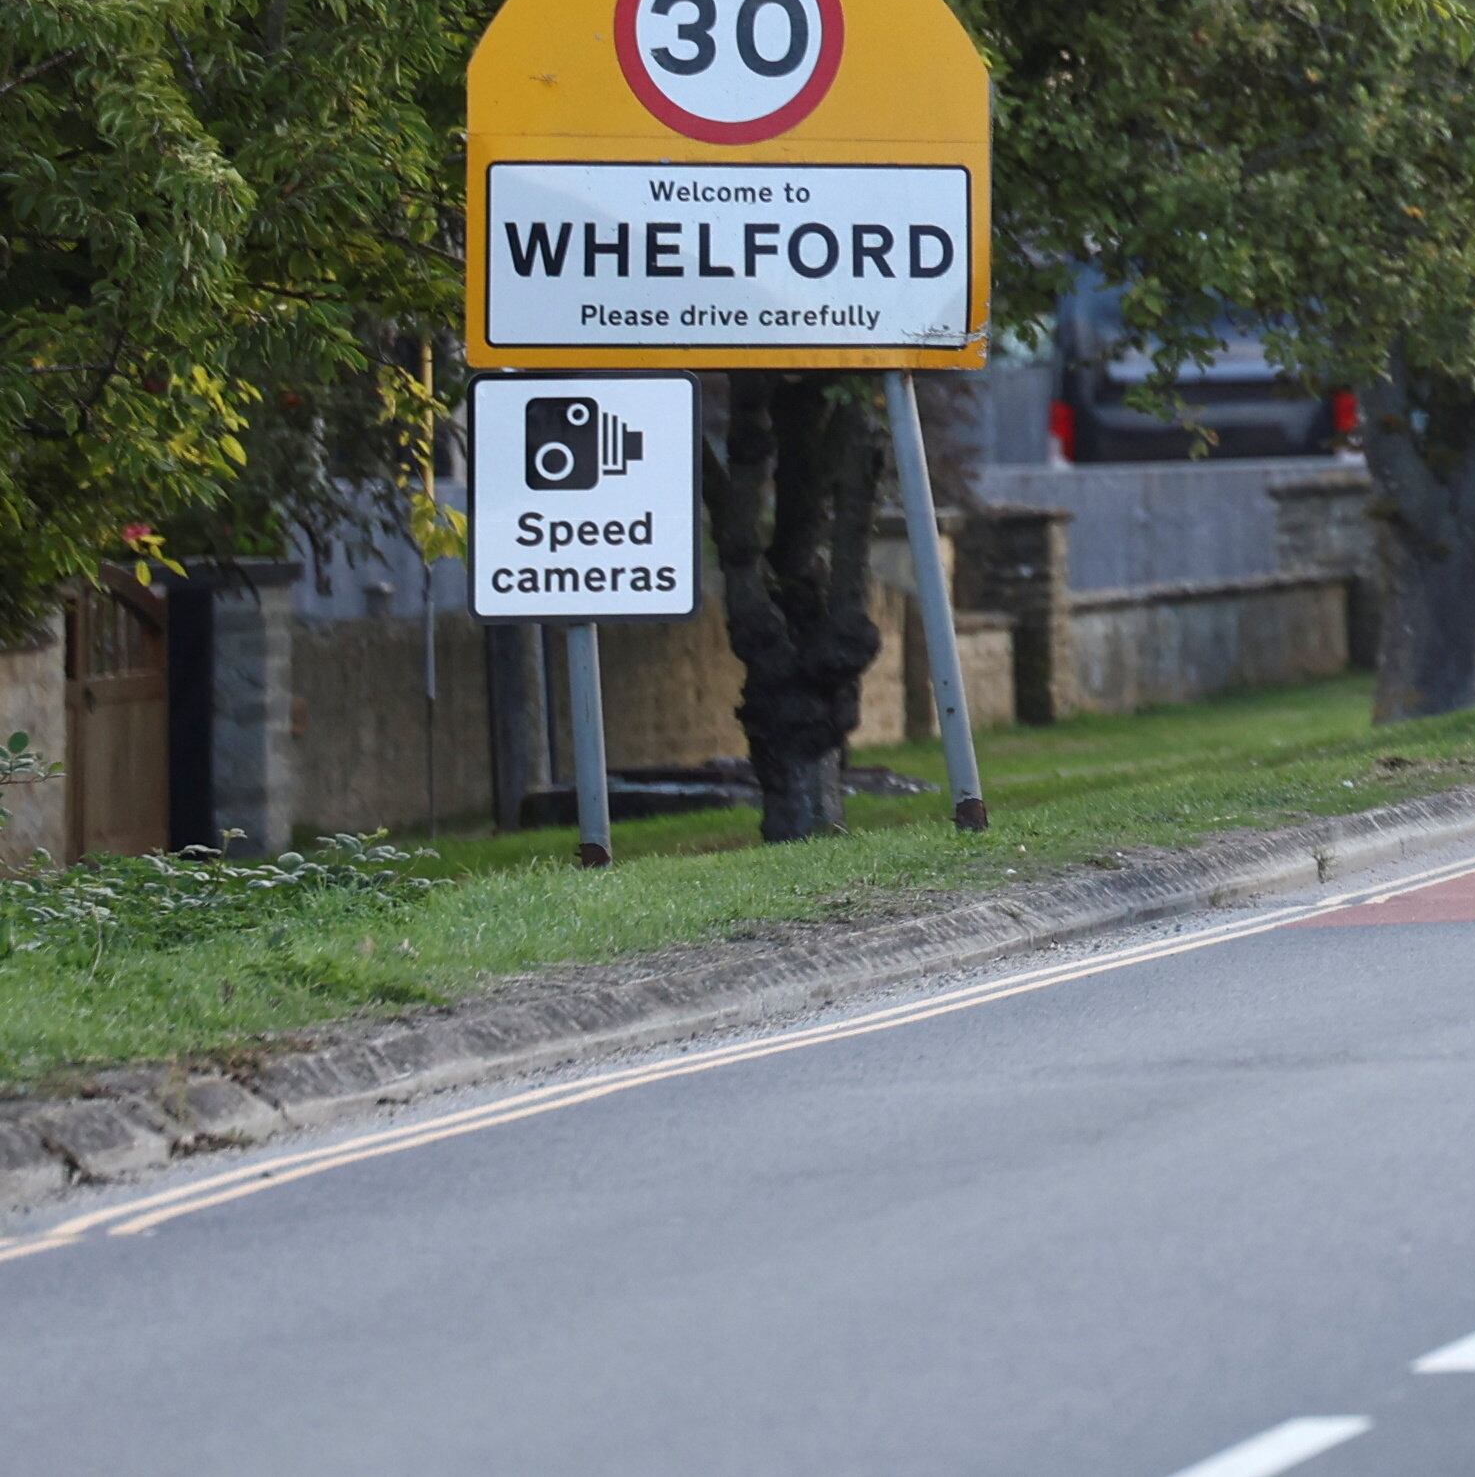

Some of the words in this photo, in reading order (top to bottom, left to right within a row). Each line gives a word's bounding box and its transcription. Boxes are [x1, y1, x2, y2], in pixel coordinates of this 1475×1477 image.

[650, 180, 773, 203] Welcome
[784, 183, 811, 203] to
[505, 221, 955, 278] WHELFORD
[581, 304, 670, 326] Please
[680, 305, 749, 326] drive
[759, 304, 881, 330] carefully
[515, 511, 653, 553] Speed
[491, 566, 677, 594] cameras
